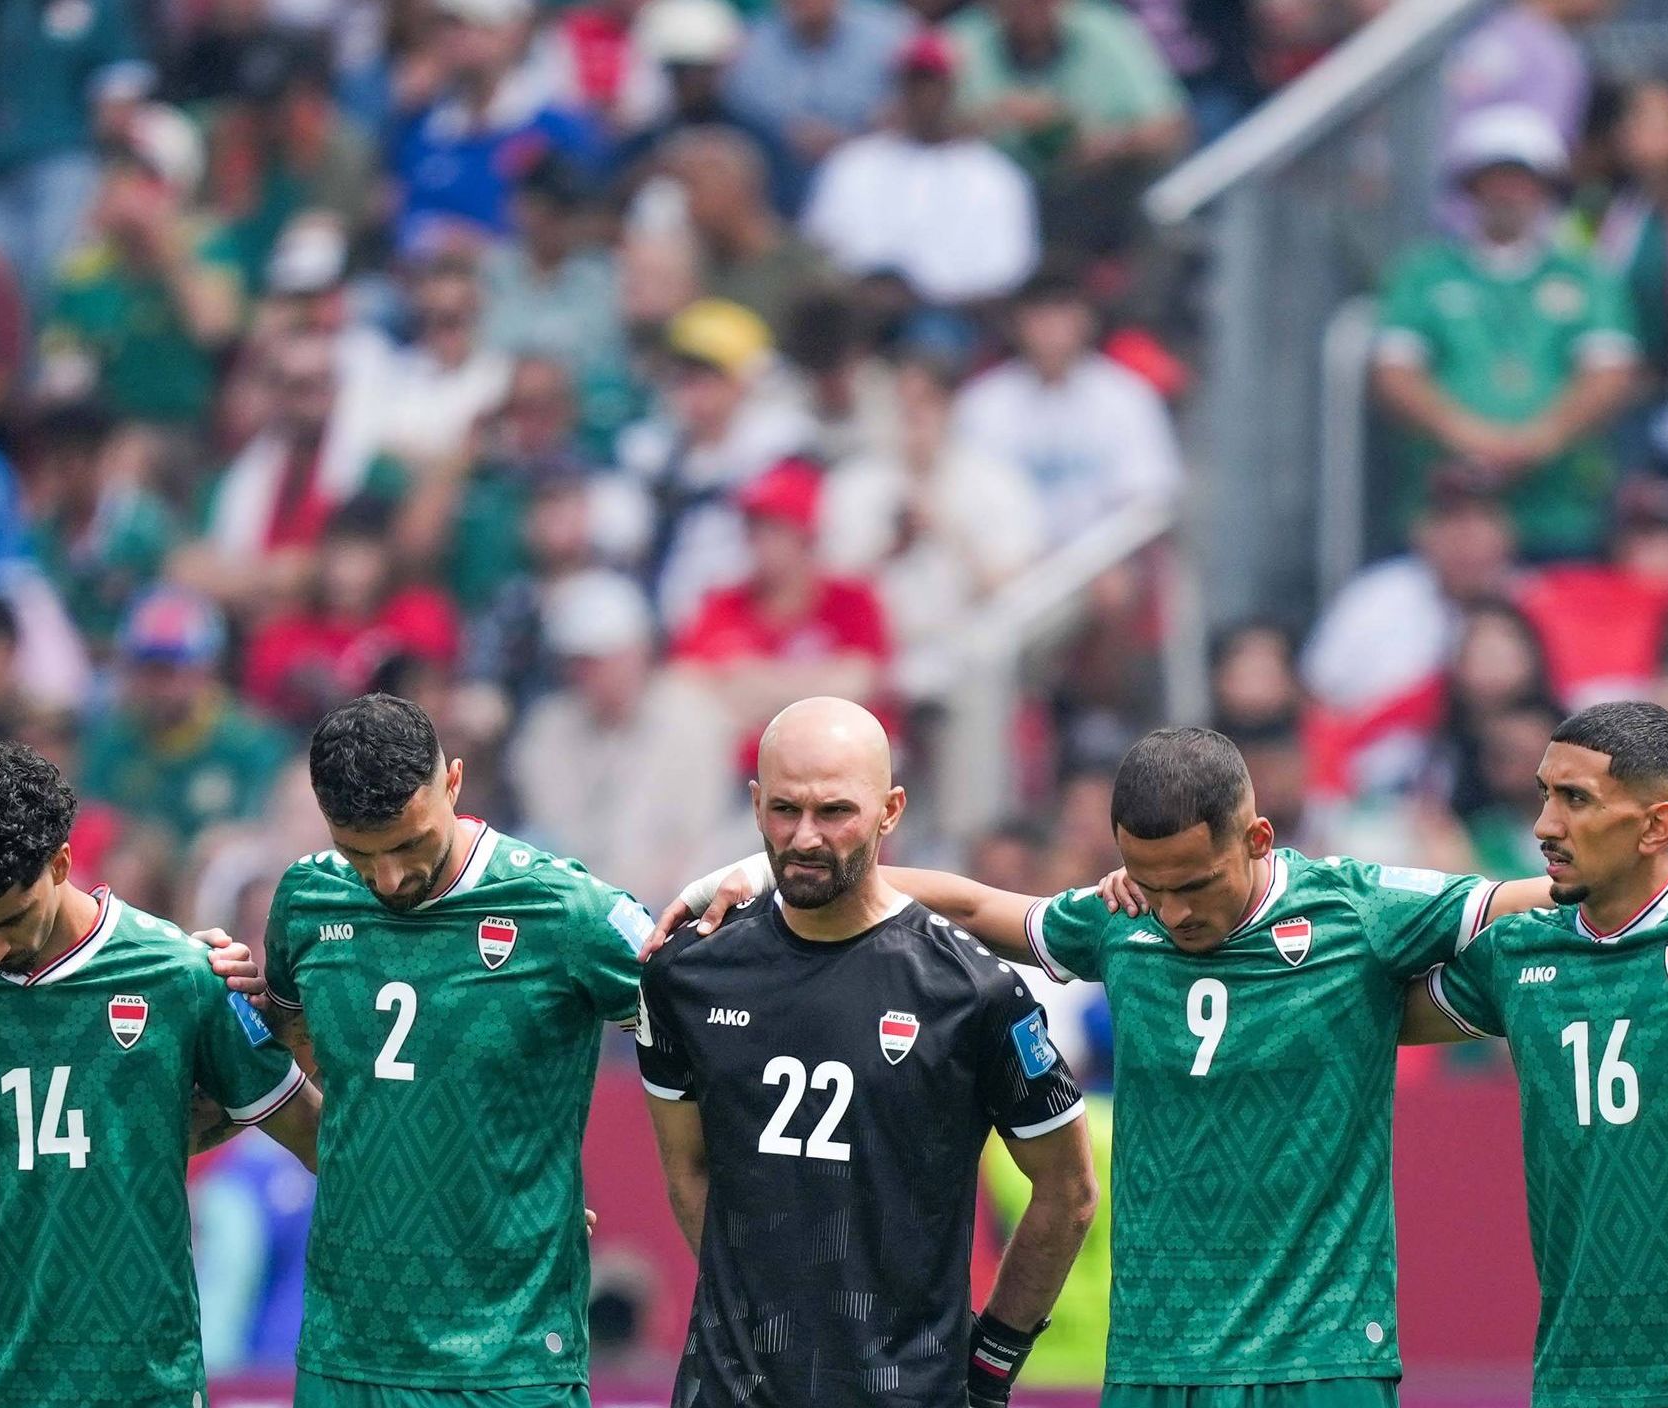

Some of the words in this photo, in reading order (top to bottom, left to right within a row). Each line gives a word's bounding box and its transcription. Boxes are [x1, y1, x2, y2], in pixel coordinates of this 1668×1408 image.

[319, 923, 354, 942] JAKO
[487, 918, 511, 927] IRAQ
[1518, 966, 1557, 985] JAKO
[374, 981, 417, 1081] 2
[707, 1007, 750, 1027] JAKO
[888, 1013, 913, 1022] IRAQ
[1186, 977, 1228, 1077] 9
[1561, 1018, 1640, 1126] 16
[0, 1065, 91, 1170] 14
[758, 1055, 854, 1161] 22
